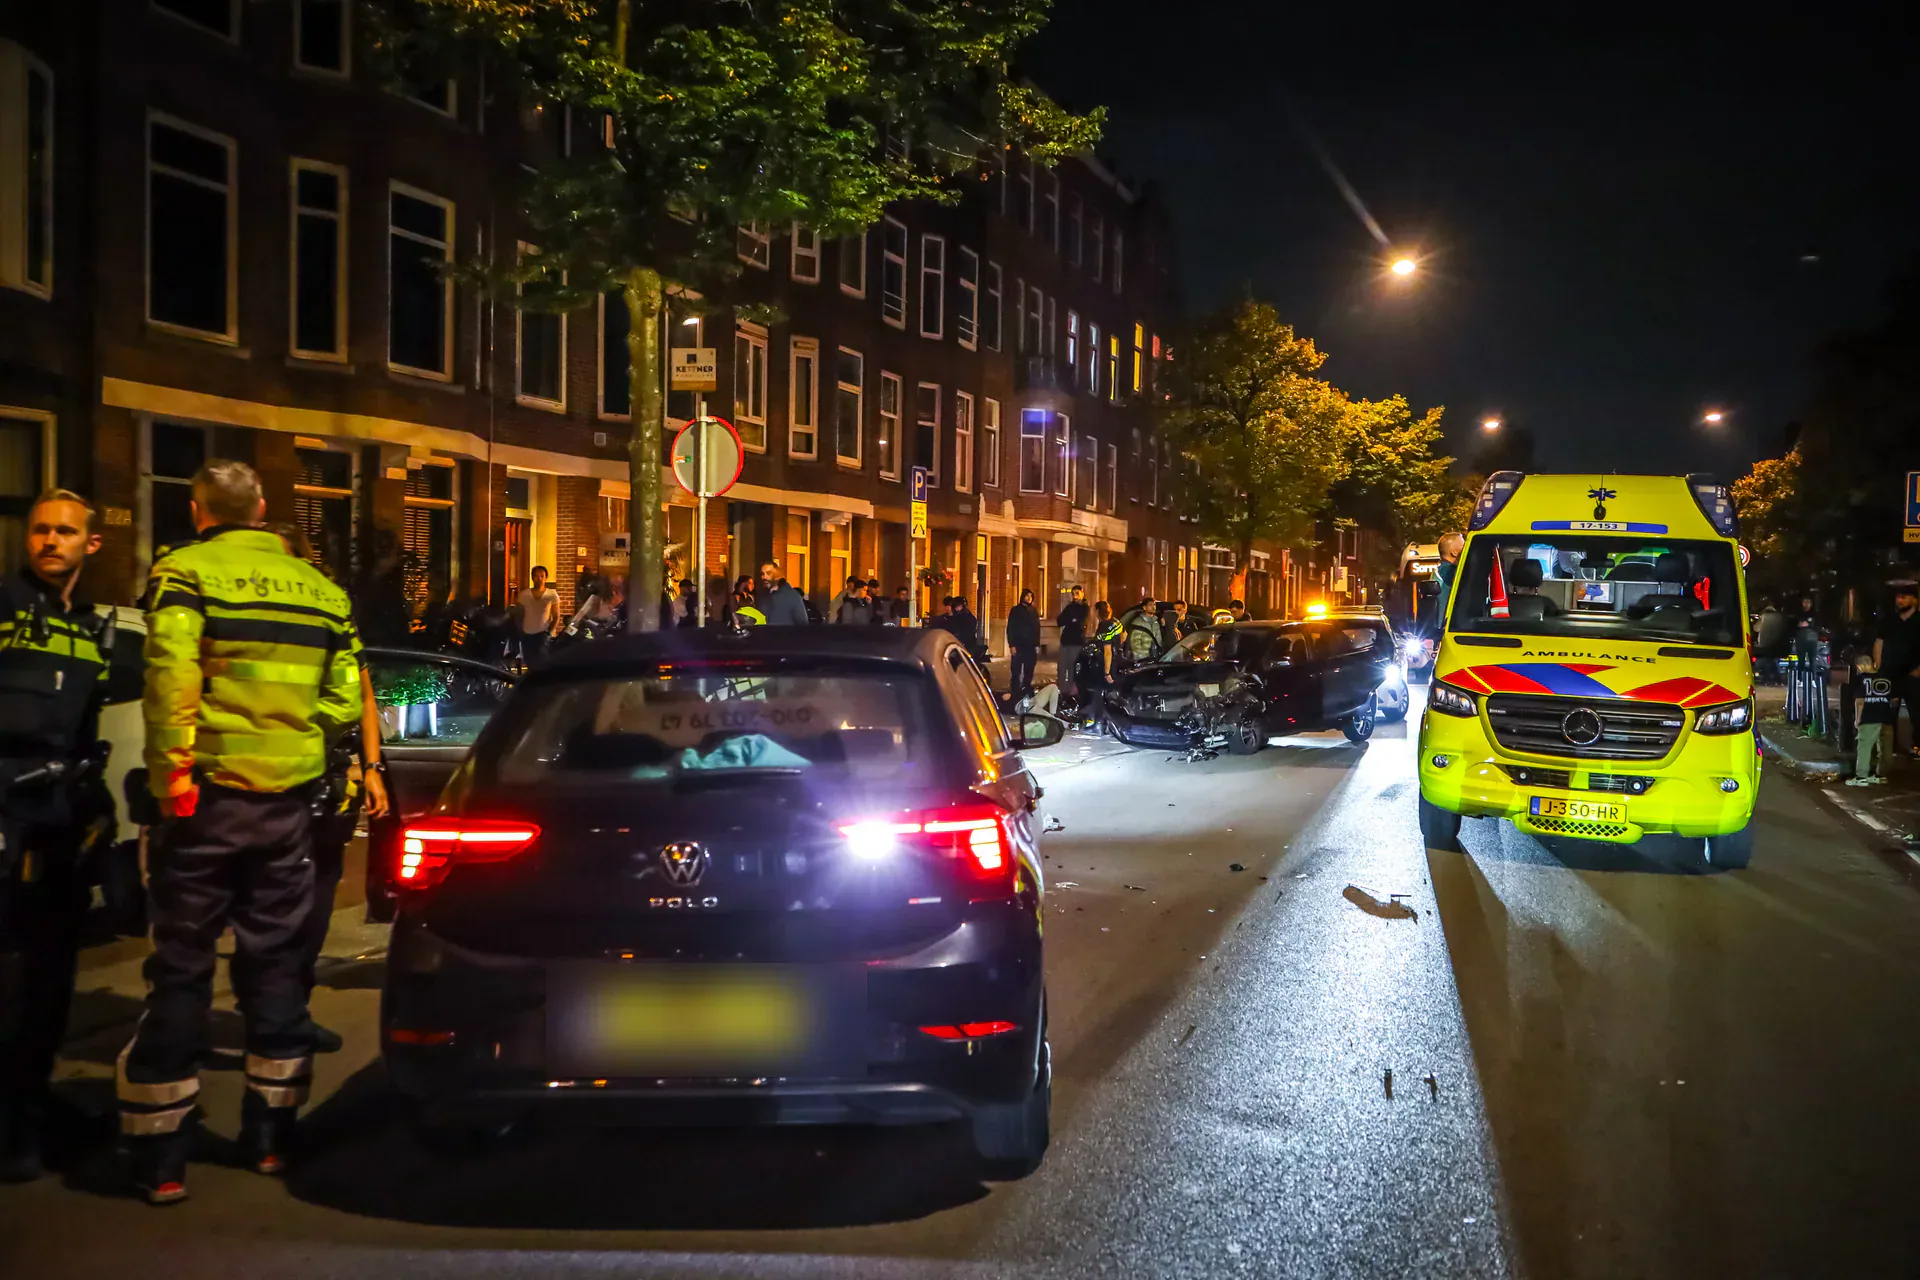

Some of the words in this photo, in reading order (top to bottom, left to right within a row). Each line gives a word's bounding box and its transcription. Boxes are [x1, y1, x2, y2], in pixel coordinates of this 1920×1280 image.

[675, 365, 714, 373] KETTNER
[915, 471, 924, 497] P
[1579, 522, 1618, 530] 17-153
[1522, 650, 1657, 664] AMBULANCE
[1863, 677, 1892, 696] 10
[1544, 801, 1619, 820] J-350-HR
[649, 897, 718, 908] POLO
